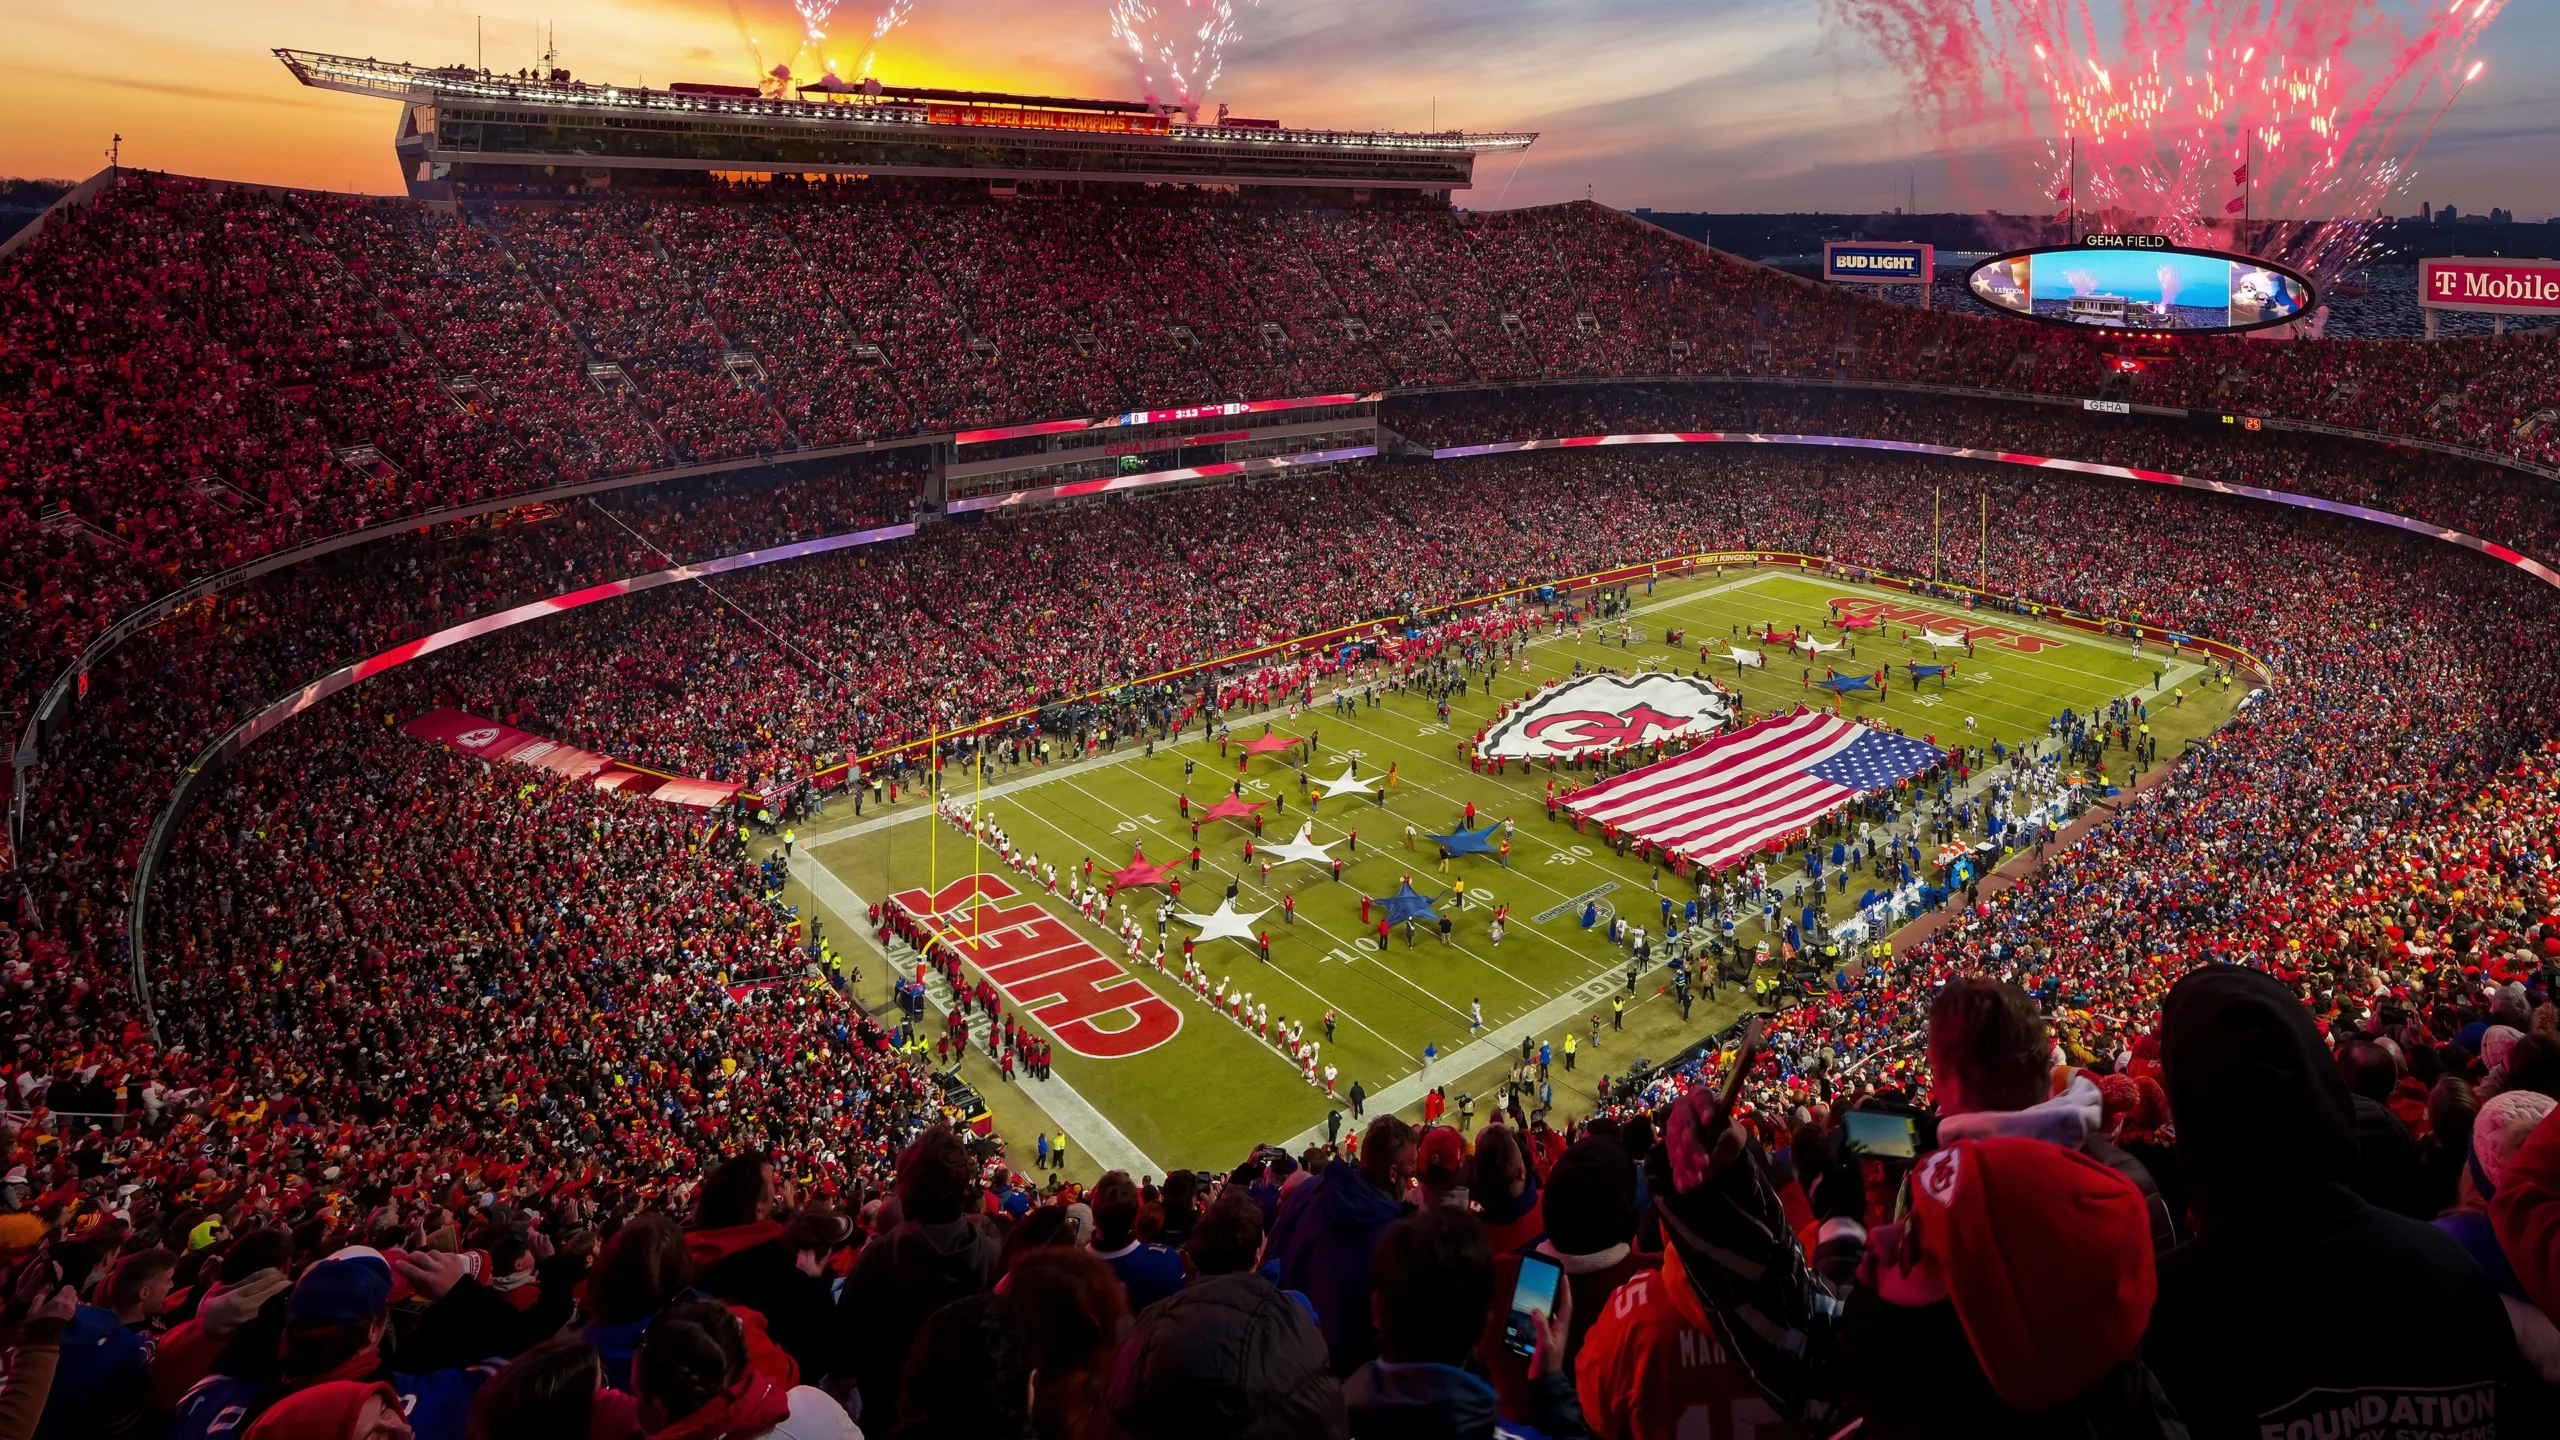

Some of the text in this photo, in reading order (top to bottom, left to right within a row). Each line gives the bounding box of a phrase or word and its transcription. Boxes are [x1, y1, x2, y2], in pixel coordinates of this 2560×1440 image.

[981, 109, 1020, 125] SUPER
[1023, 112, 1057, 127] BOWL
[1060, 113, 1126, 130] CHAMPIONS
[2086, 235, 2165, 248] GEHA FIELD
[1836, 255, 1915, 270] BUD LIGHT
[1994, 287, 2025, 295] FREEDOM
[2463, 272, 2560, 301] Mobile
[1175, 409, 1199, 419] 3:13
[2090, 401, 2123, 413] GEHA
[2247, 419, 2259, 429] 25
[1104, 442, 1143, 457] GEHA
[1146, 437, 1183, 452] FIELD
[1695, 555, 1719, 564] CHIEFS
[1826, 596, 2069, 654] CHIEFS
[1912, 693, 1943, 707] 20
[1116, 811, 1163, 834] 10
[1550, 845, 1594, 866] 30
[1448, 887, 1495, 913] 20
[1538, 883, 1615, 921] CHAMPIONSHIP
[1328, 936, 1380, 965] 10
[888, 872, 1185, 1060] CHIEFS
[2259, 1388, 2496, 1440] FOUNDATION
